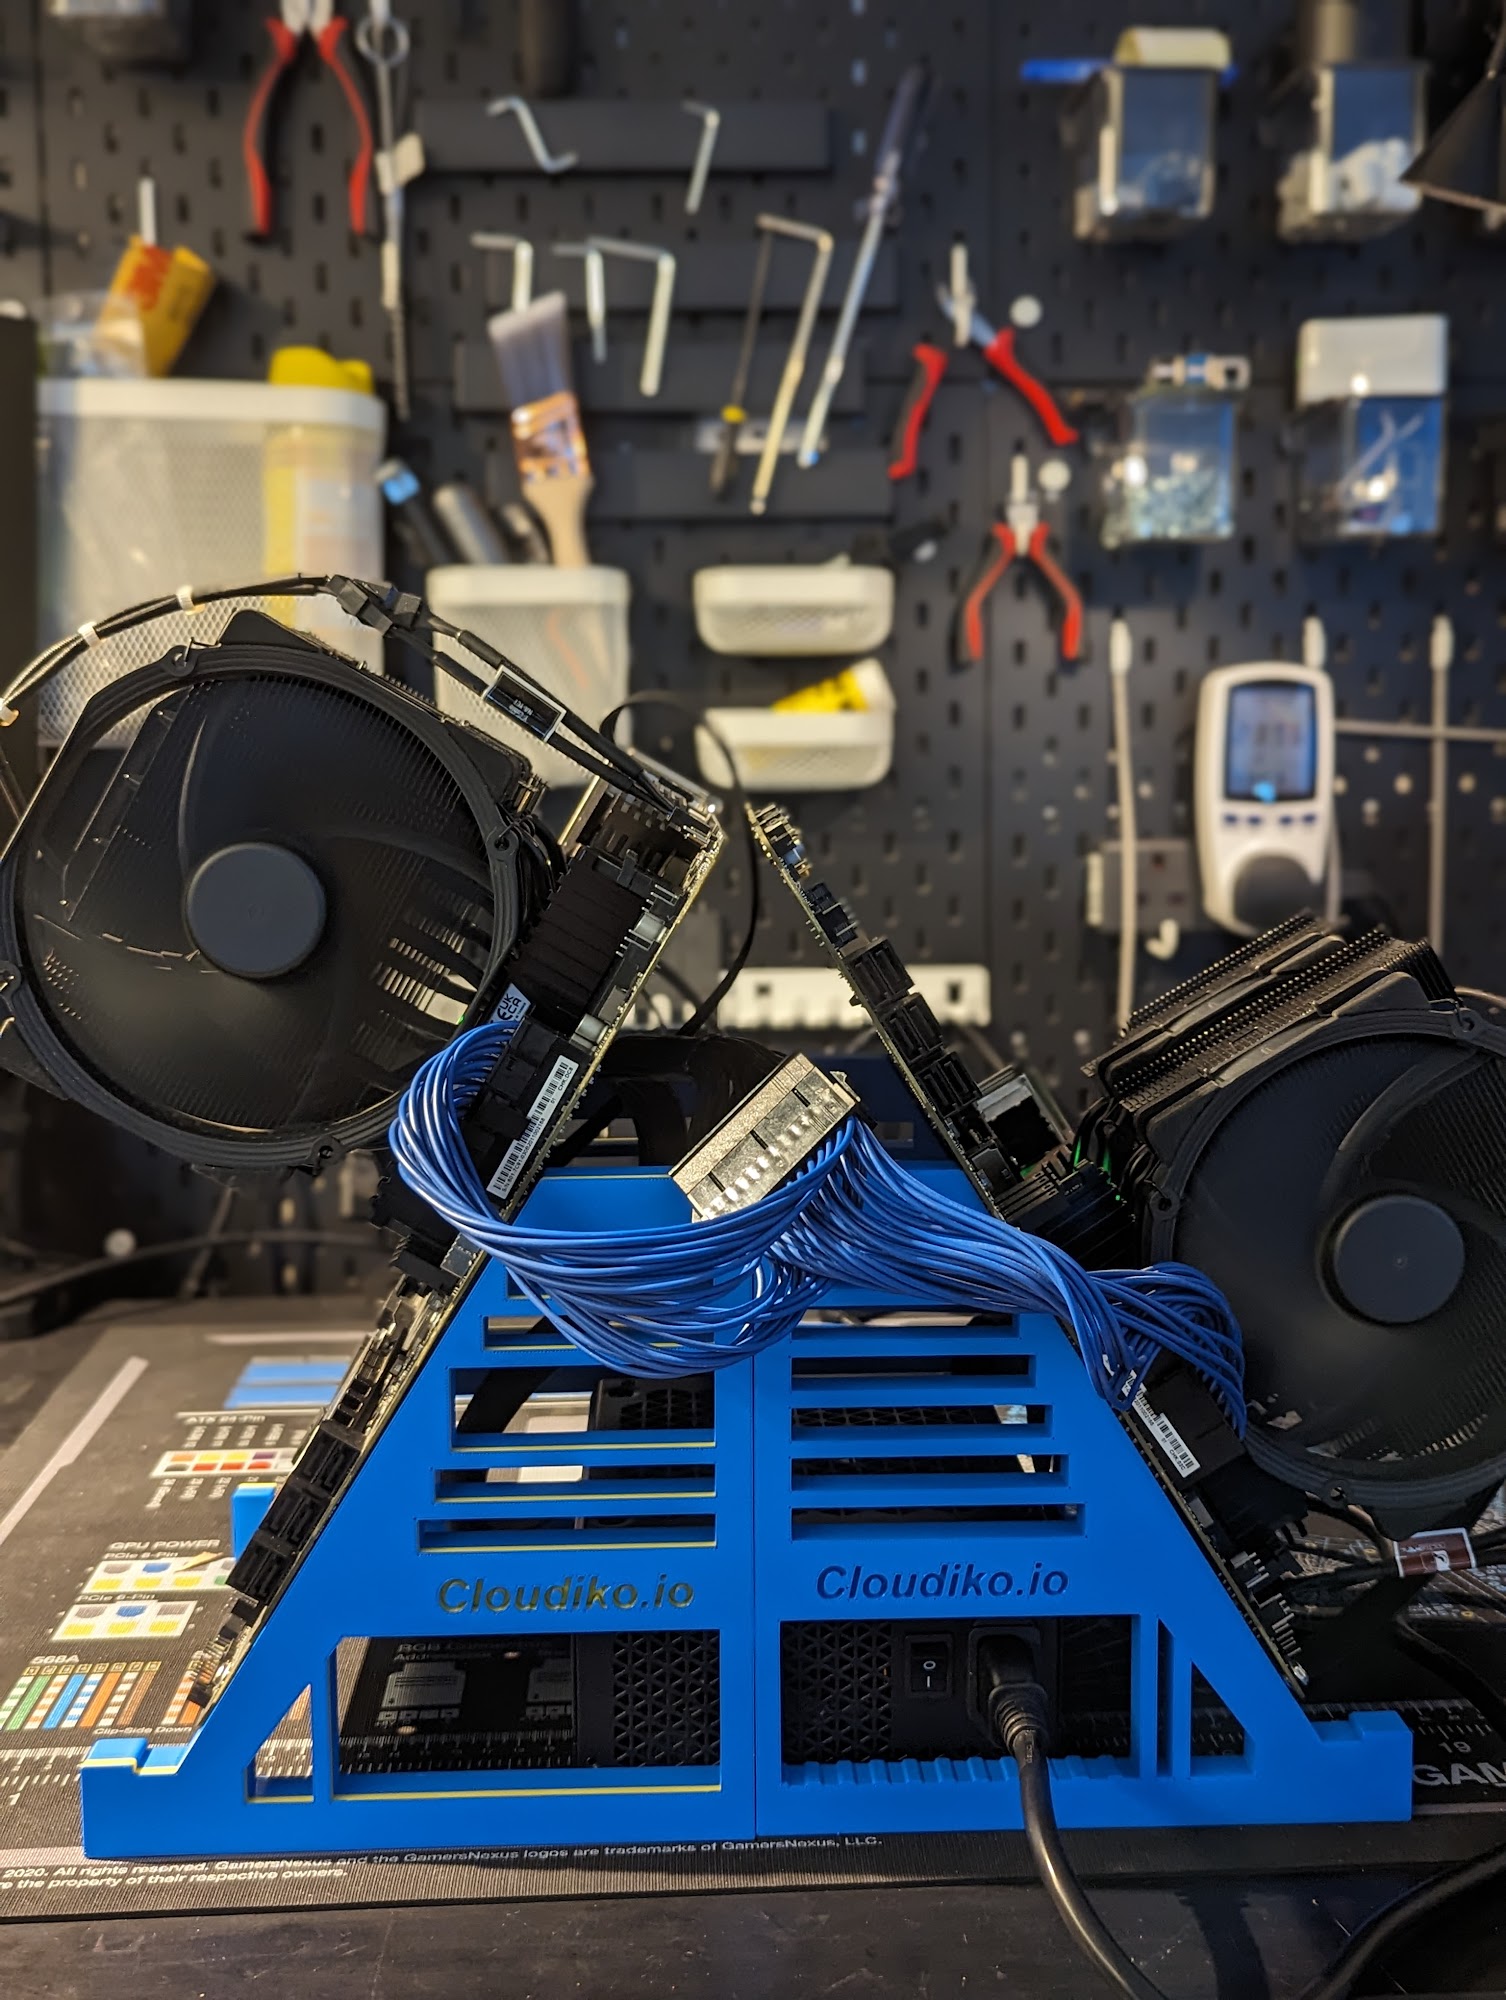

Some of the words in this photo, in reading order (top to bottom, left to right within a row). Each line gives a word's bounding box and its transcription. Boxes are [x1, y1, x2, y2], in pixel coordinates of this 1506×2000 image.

[499, 992, 515, 1011] UK
[506, 996, 522, 1015] CA
[109, 1541, 150, 1551] GPU
[152, 1539, 221, 1549] POWER
[816, 1561, 1069, 1600] Cloudiko.io
[77, 1595, 113, 1603] PCIe
[438, 1573, 695, 1614] Cloudiko.io
[94, 1727, 153, 1736] Clip-Side
[155, 1726, 192, 1734] Down
[1439, 1741, 1472, 1754] 19
[3, 1867, 49, 1878] 2020.
[53, 1866, 77, 1876] All
[79, 1865, 128, 1877] rights
[132, 1862, 209, 1874] reserved.
[214, 1858, 333, 1870] GamersNexus
[336, 1856, 367, 1865] and
[372, 1855, 399, 1863] the
[404, 1850, 519, 1863] GamersNexus
[523, 1849, 568, 1860] logos
[573, 1848, 600, 1856] are
[604, 1843, 696, 1855] trademarks
[700, 1841, 717, 1851] of
[722, 1839, 840, 1850] GamersNexus,
[844, 1836, 883, 1846] LLC.
[17, 1879, 43, 1888] the
[47, 1877, 122, 1889] property
[125, 1875, 145, 1885] of
[148, 1873, 188, 1884] their
[189, 1870, 279, 1883] respective
[281, 1868, 348, 1879] owners.
